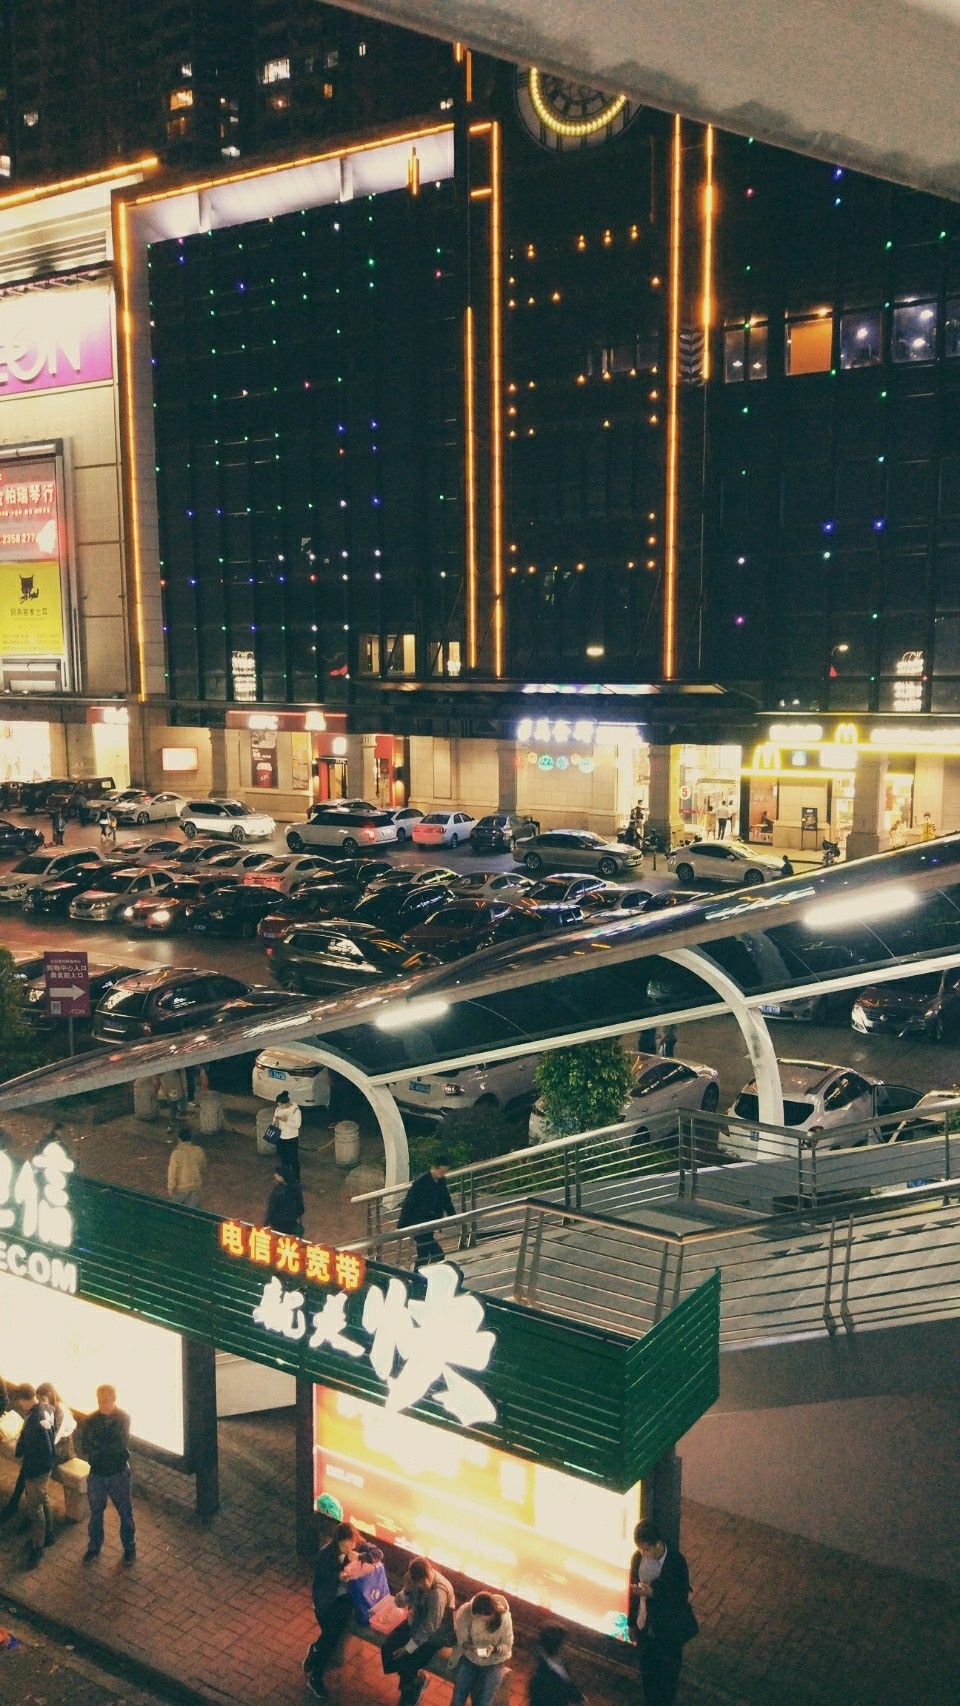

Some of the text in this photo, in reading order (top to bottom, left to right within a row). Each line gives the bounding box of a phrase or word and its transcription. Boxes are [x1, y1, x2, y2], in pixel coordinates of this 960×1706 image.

[46, 964, 87, 972] 购物中心入口
[220, 1219, 362, 1290] 电信光宽带
